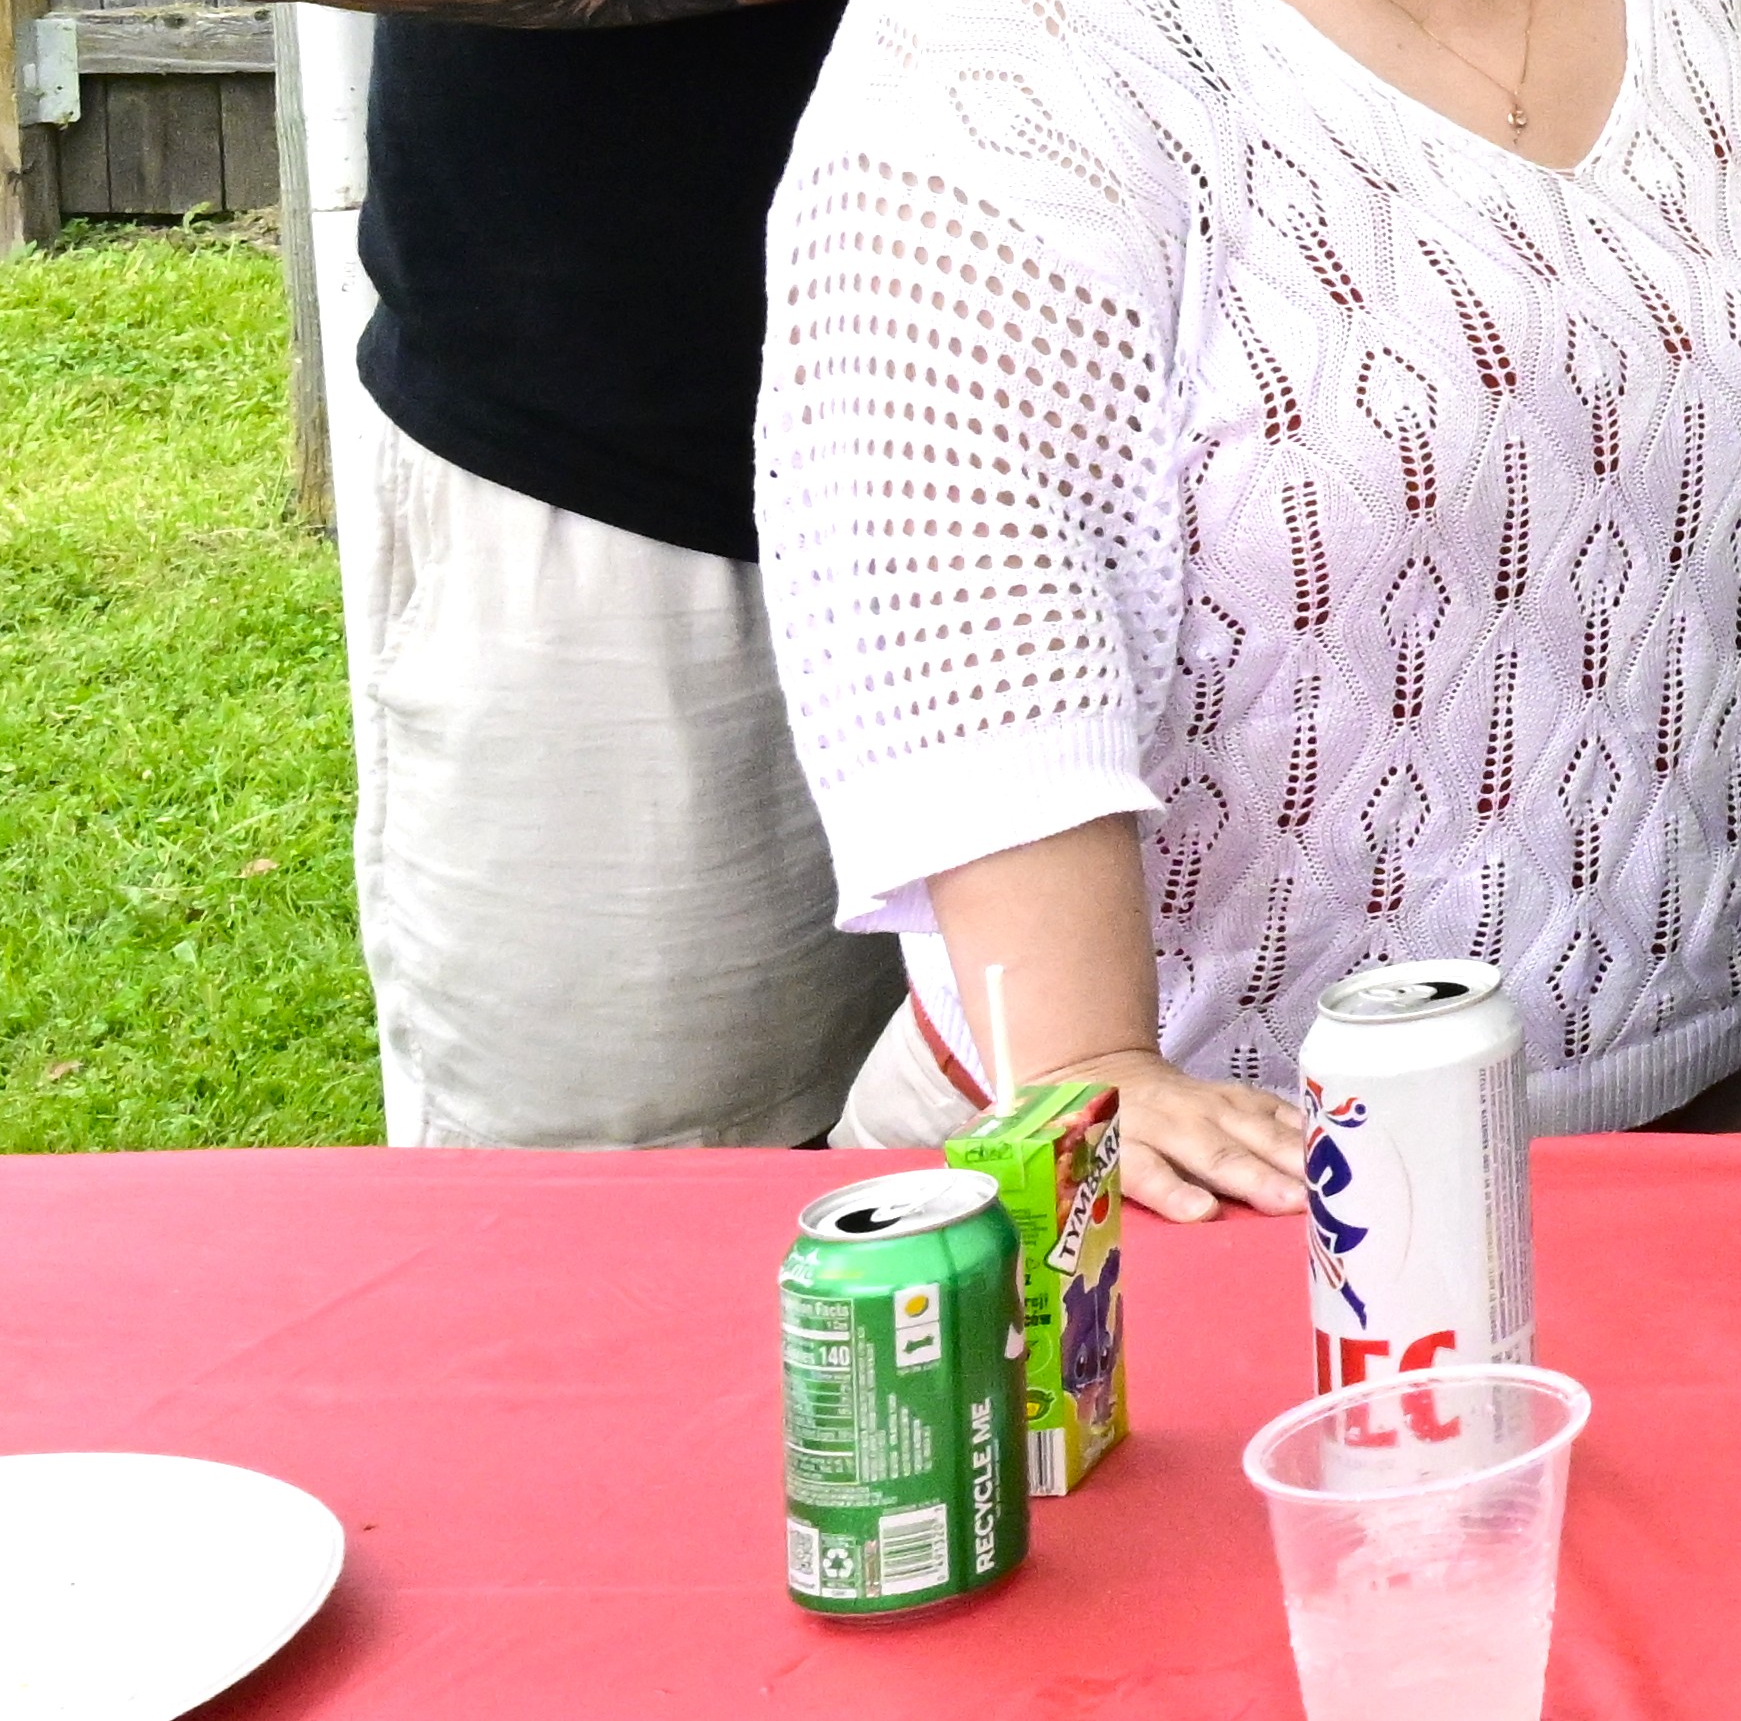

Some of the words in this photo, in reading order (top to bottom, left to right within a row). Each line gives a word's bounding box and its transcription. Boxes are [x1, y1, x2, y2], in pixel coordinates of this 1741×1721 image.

[819, 1345, 850, 1366] 140
[971, 1396, 993, 1449] ME
[972, 1446, 996, 1574] RECYCLE
